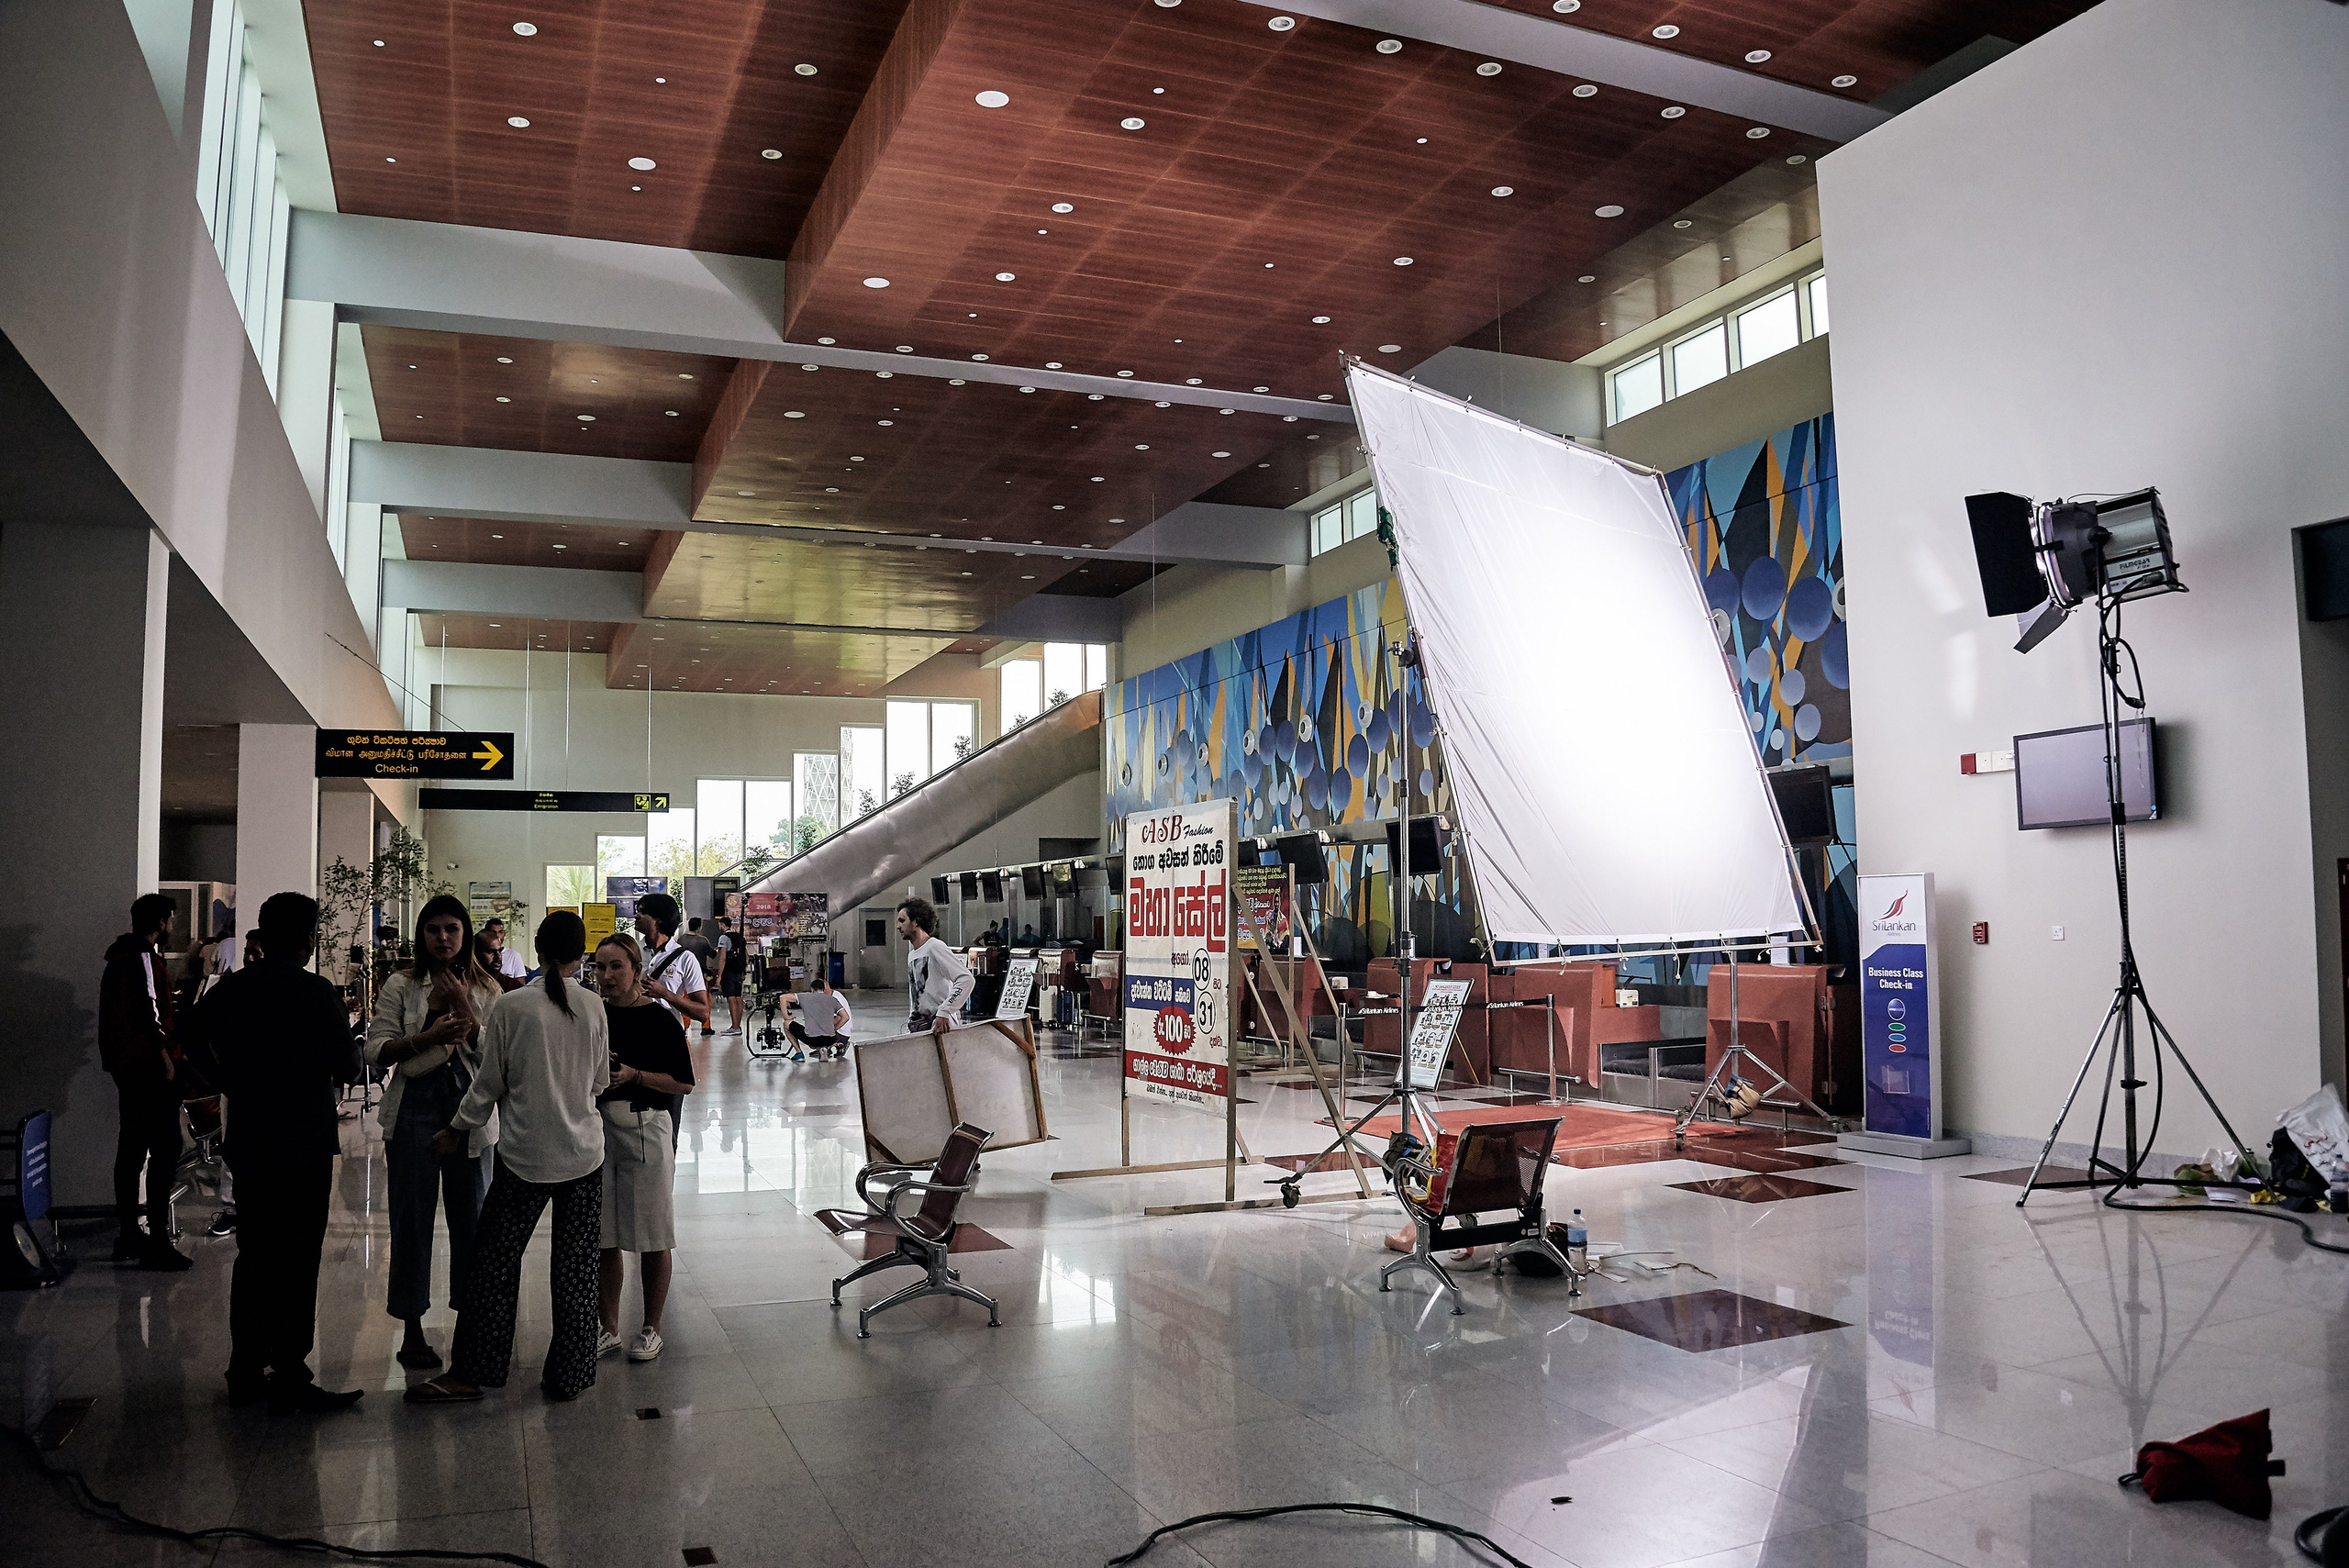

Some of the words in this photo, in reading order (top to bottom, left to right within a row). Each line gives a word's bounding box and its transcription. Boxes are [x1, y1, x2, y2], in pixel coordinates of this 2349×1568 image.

[325, 748, 353, 758] விமான
[417, 750, 467, 761] பரிசோதனை
[374, 764, 418, 773] Check-in
[1141, 815, 1184, 844] ASB
[1183, 824, 1213, 840] Fashion
[1132, 853, 1155, 871] තොග
[1158, 846, 1189, 873] අවසන්
[1192, 840, 1223, 866] කිරීමේ
[1872, 920, 1916, 931] SriLankan
[1194, 956, 1208, 982] 08
[1868, 966, 1902, 978] Business
[1902, 967, 1924, 979] Class
[1879, 978, 1913, 990] Check-in
[1198, 1001, 1213, 1027] 31
[1164, 1014, 1184, 1043] 100
[1149, 1059, 1169, 1079] ASB
